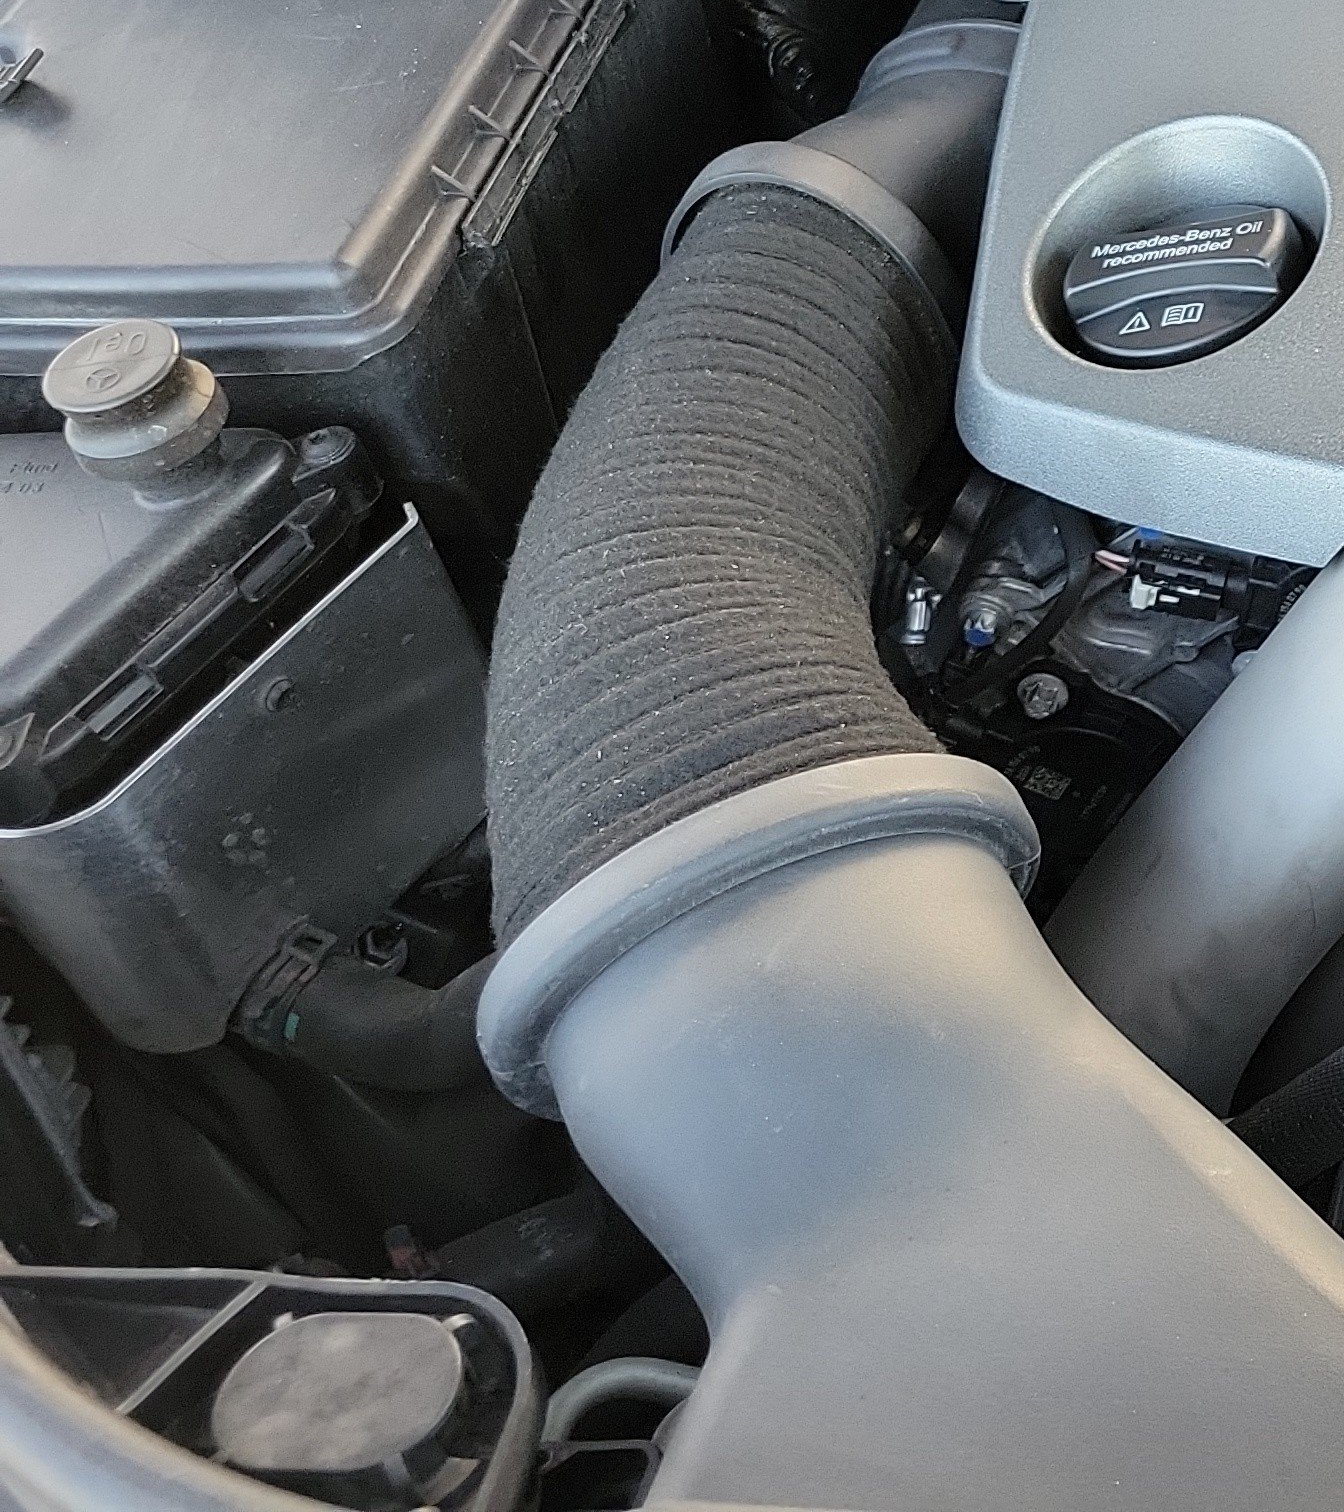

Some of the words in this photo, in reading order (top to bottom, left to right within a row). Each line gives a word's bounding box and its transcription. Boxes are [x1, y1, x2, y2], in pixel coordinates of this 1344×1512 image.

[1091, 226, 1232, 260] Mercedes-Benz
[1235, 221, 1264, 236] Oil
[1102, 238, 1234, 270] recommended
